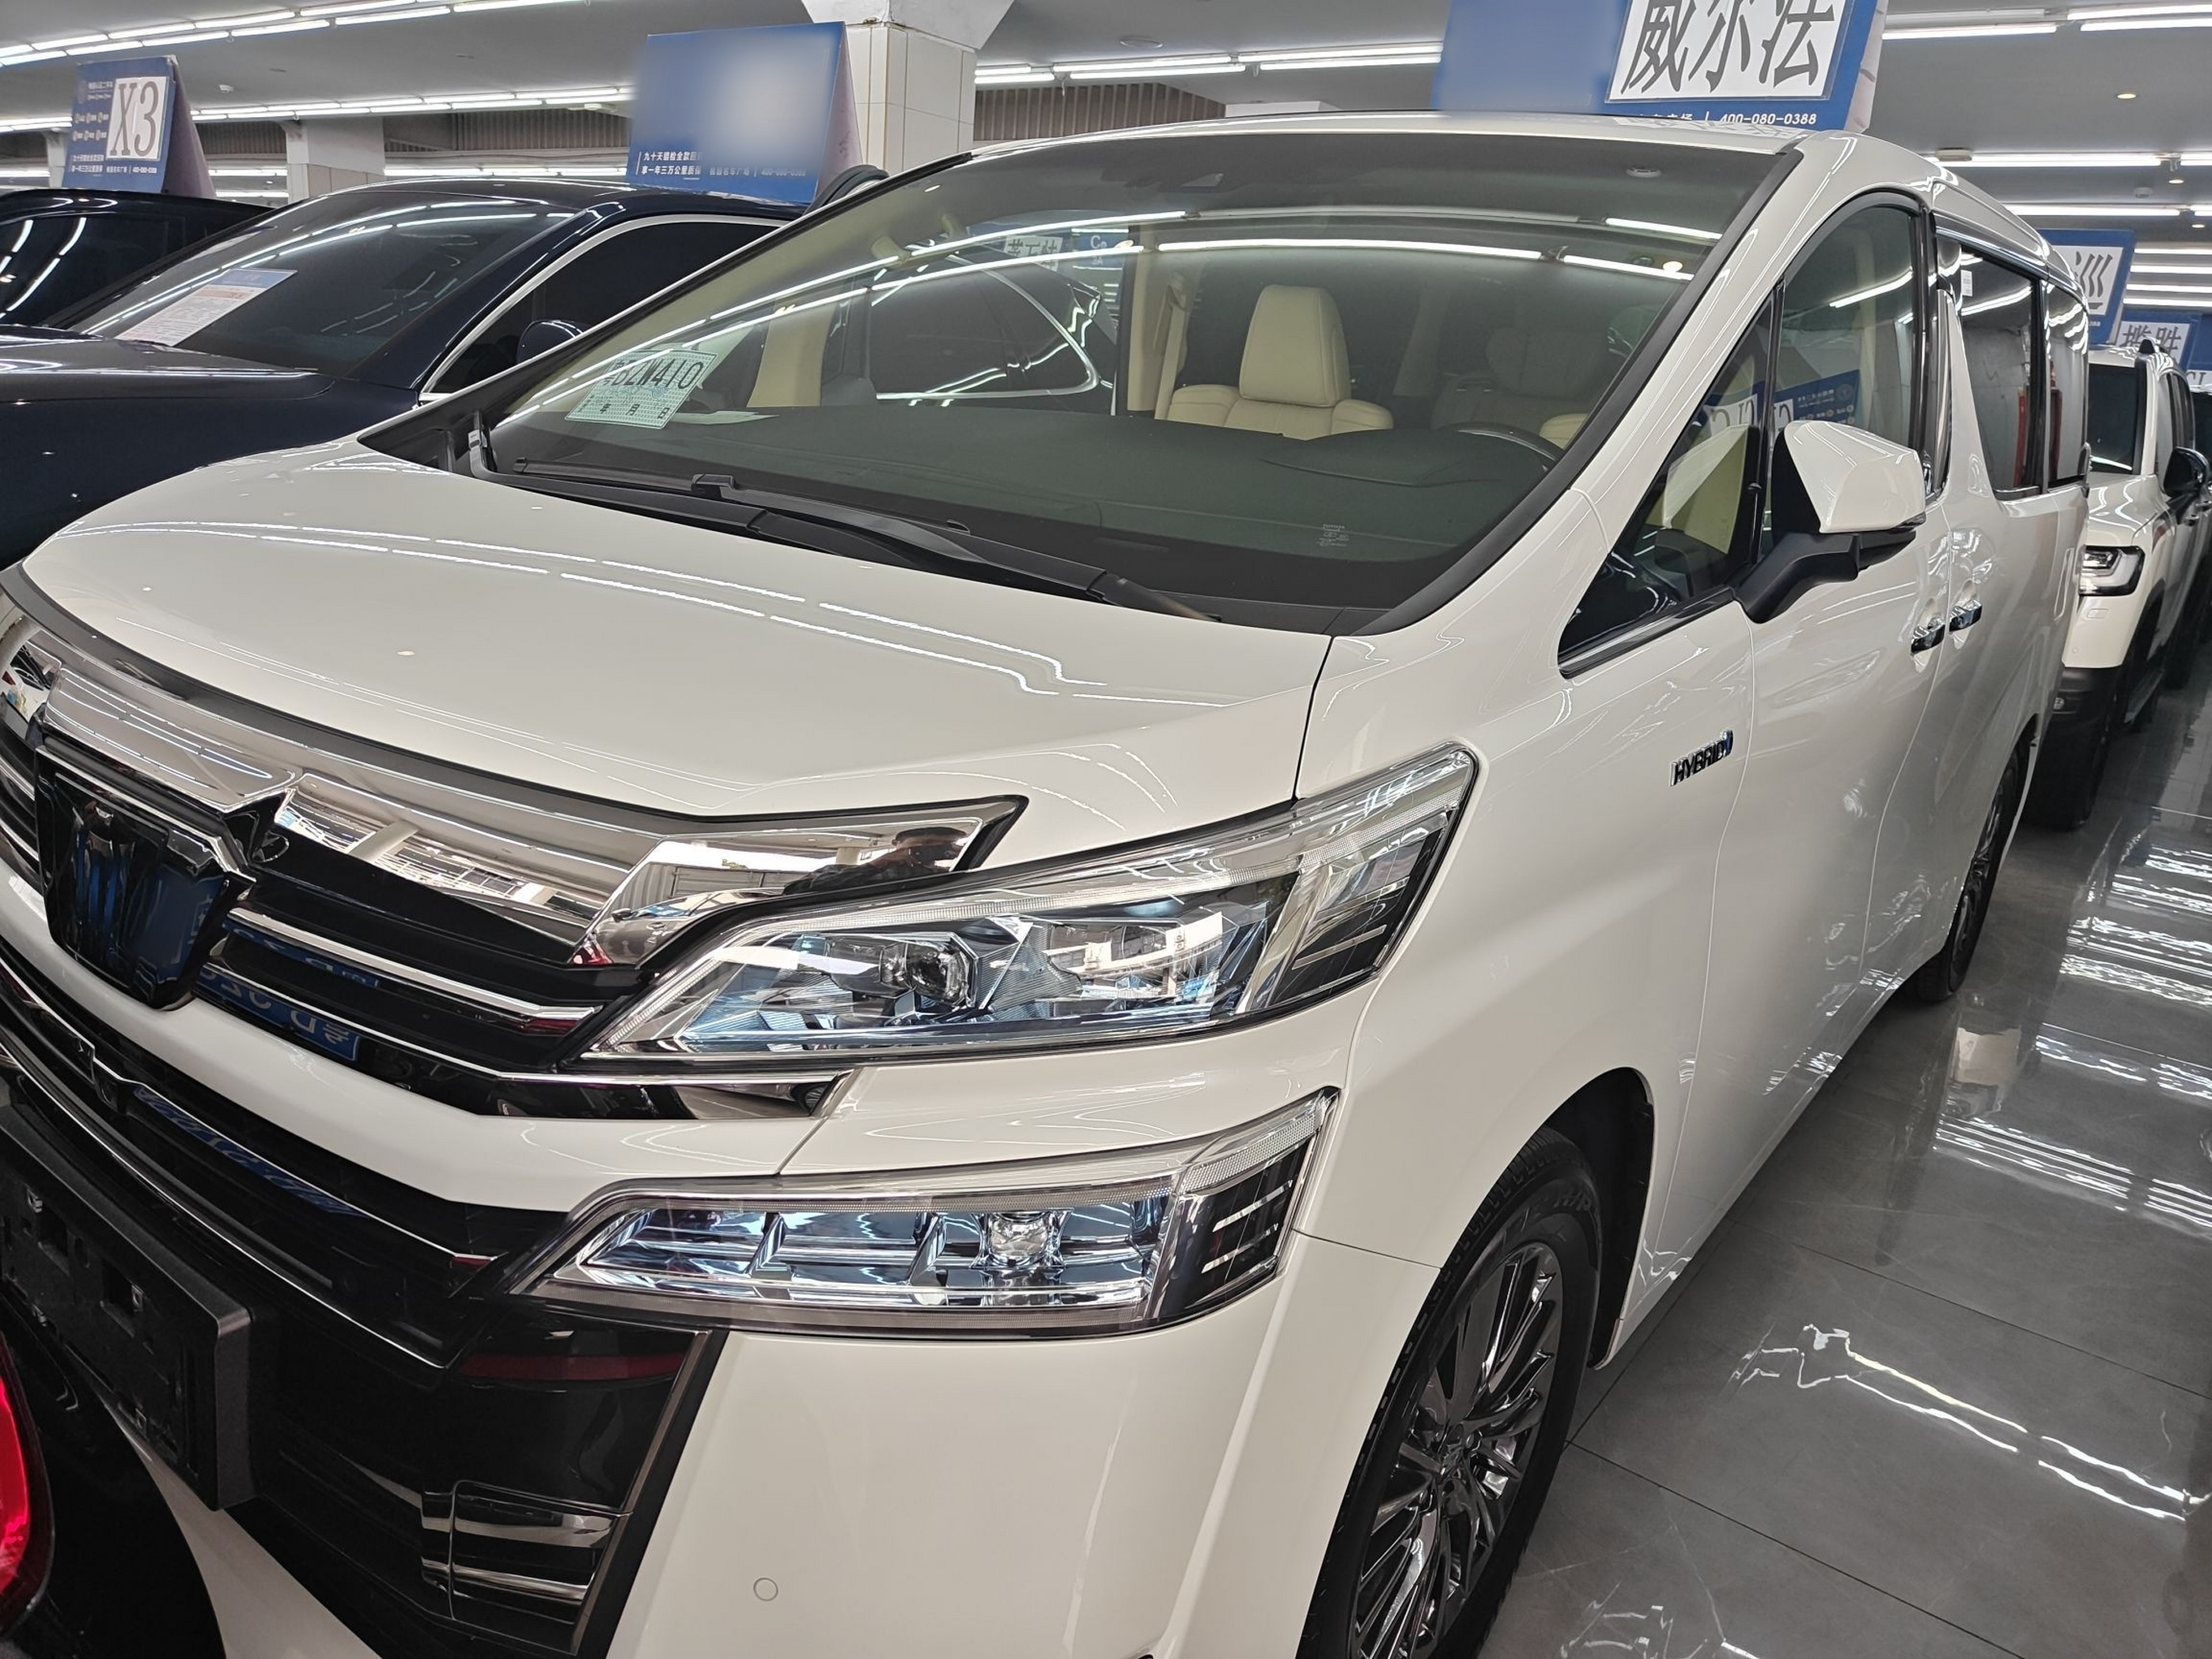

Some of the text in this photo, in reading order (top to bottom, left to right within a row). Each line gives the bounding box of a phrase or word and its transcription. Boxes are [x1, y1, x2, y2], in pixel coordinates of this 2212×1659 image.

[1621, 0, 1834, 94] 威尔法
[110, 81, 159, 157] X3
[1719, 113, 1817, 125] 400-080-0388
[626, 404, 640, 416] 月
[657, 407, 671, 419] 日
[1670, 738, 1727, 787] HYBRID
